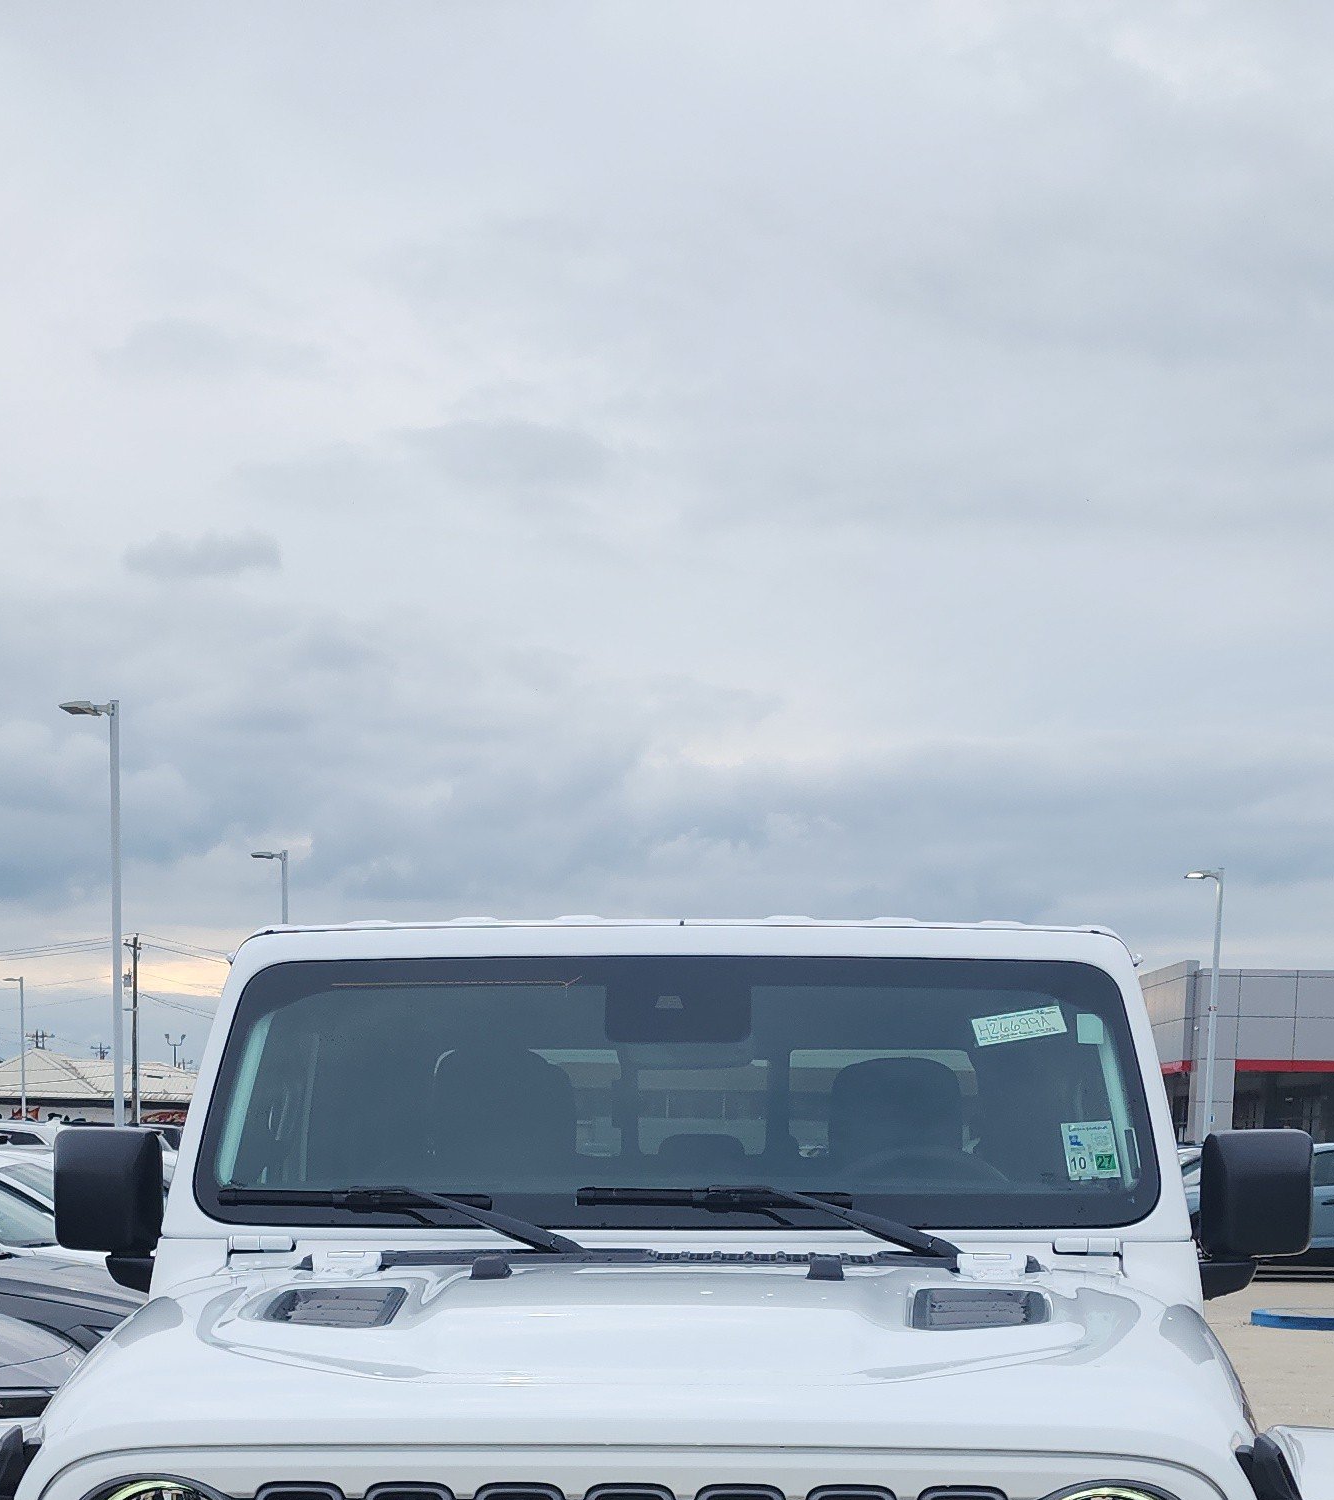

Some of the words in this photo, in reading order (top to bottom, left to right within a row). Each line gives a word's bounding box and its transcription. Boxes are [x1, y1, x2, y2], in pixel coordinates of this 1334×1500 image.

[978, 1016, 1051, 1036] H26699A
[1070, 1156, 1087, 1170] 10
[1097, 1155, 1113, 1168] 27
